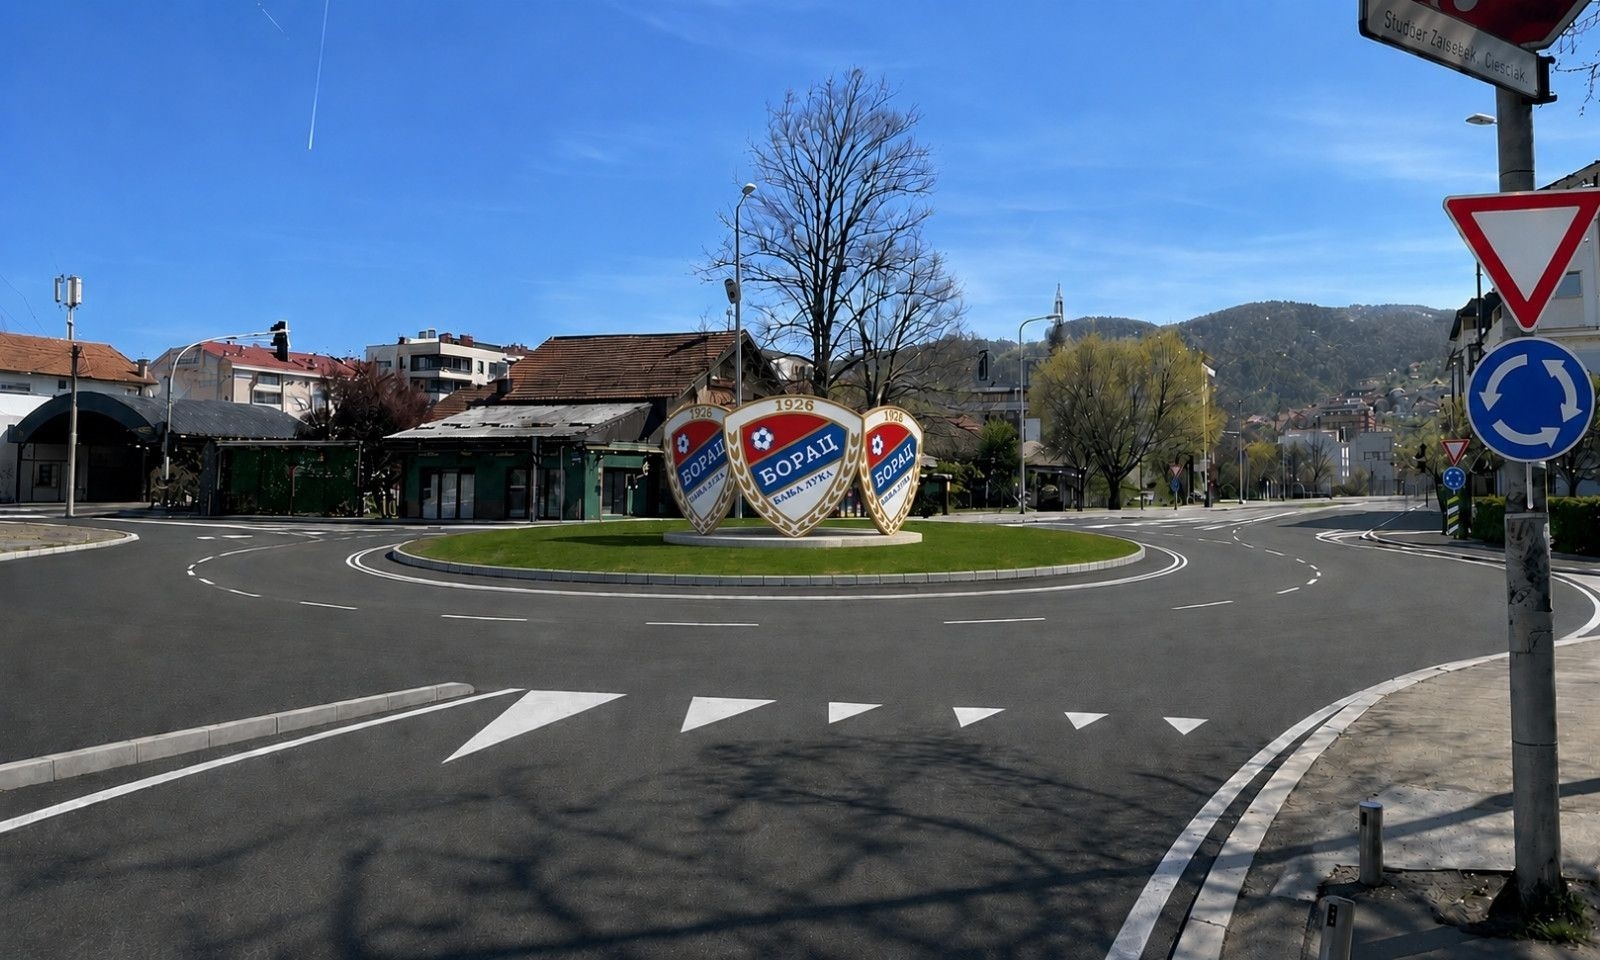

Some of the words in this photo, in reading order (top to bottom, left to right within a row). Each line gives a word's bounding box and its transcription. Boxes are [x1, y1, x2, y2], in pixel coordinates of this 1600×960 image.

[689, 407, 713, 419] 1926
[775, 398, 815, 412] 1926
[758, 433, 839, 487] БОРАЦ
[875, 443, 915, 488] БОРАЦ
[772, 485, 804, 505] БАЊА
[805, 470, 834, 490] ЛУКА
